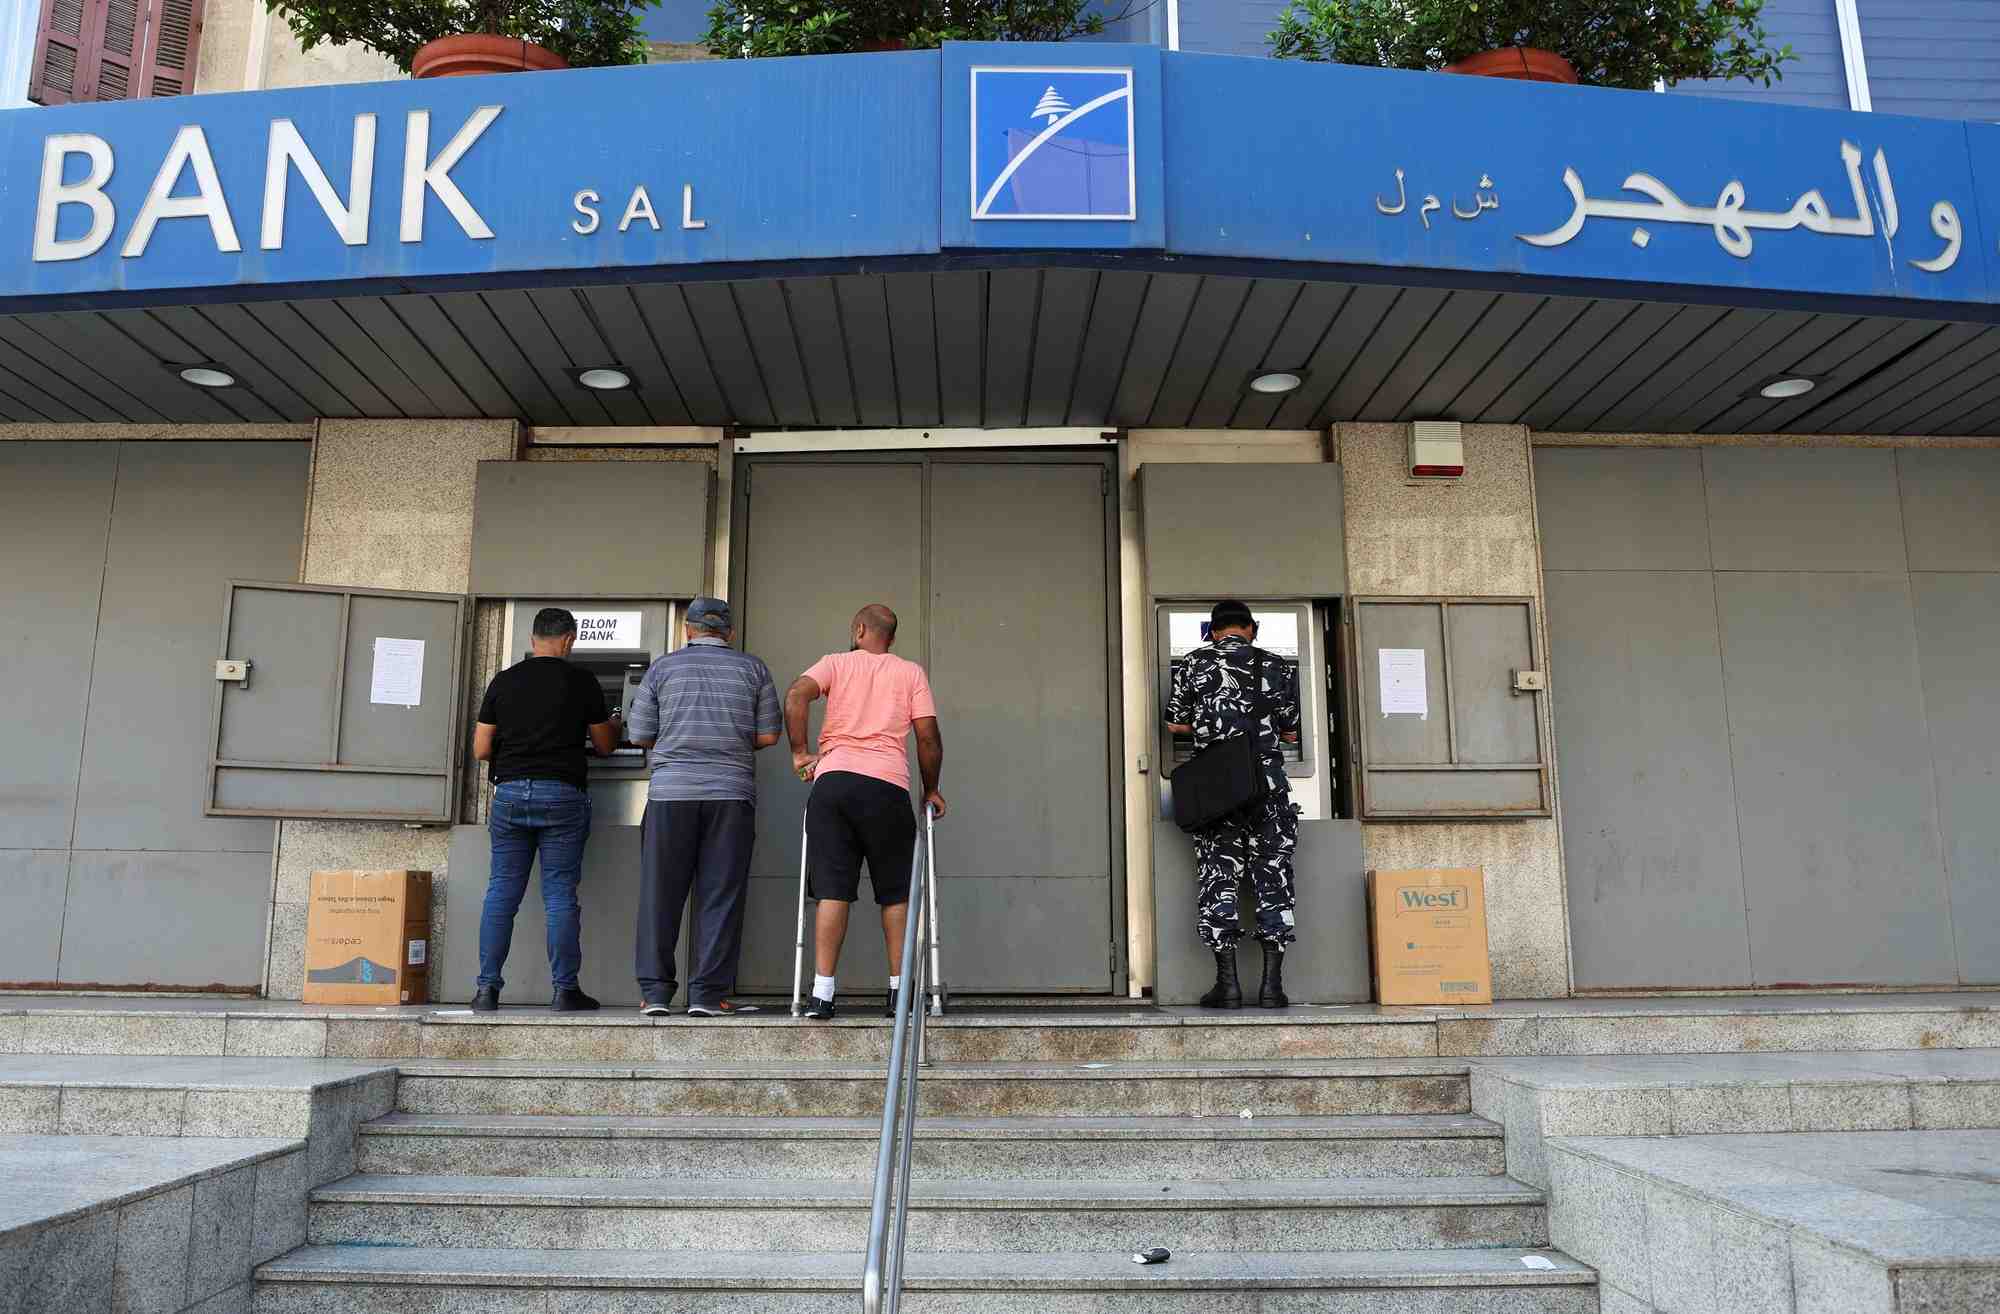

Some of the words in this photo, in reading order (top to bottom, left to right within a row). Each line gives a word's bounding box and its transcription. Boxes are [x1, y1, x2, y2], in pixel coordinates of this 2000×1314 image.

[32, 104, 504, 262] BANK
[572, 183, 707, 236] SAL
[1516, 140, 1962, 272] والمهجر
[581, 618, 617, 629] BLOM
[579, 630, 615, 640] BANK
[1401, 889, 1457, 907] West
